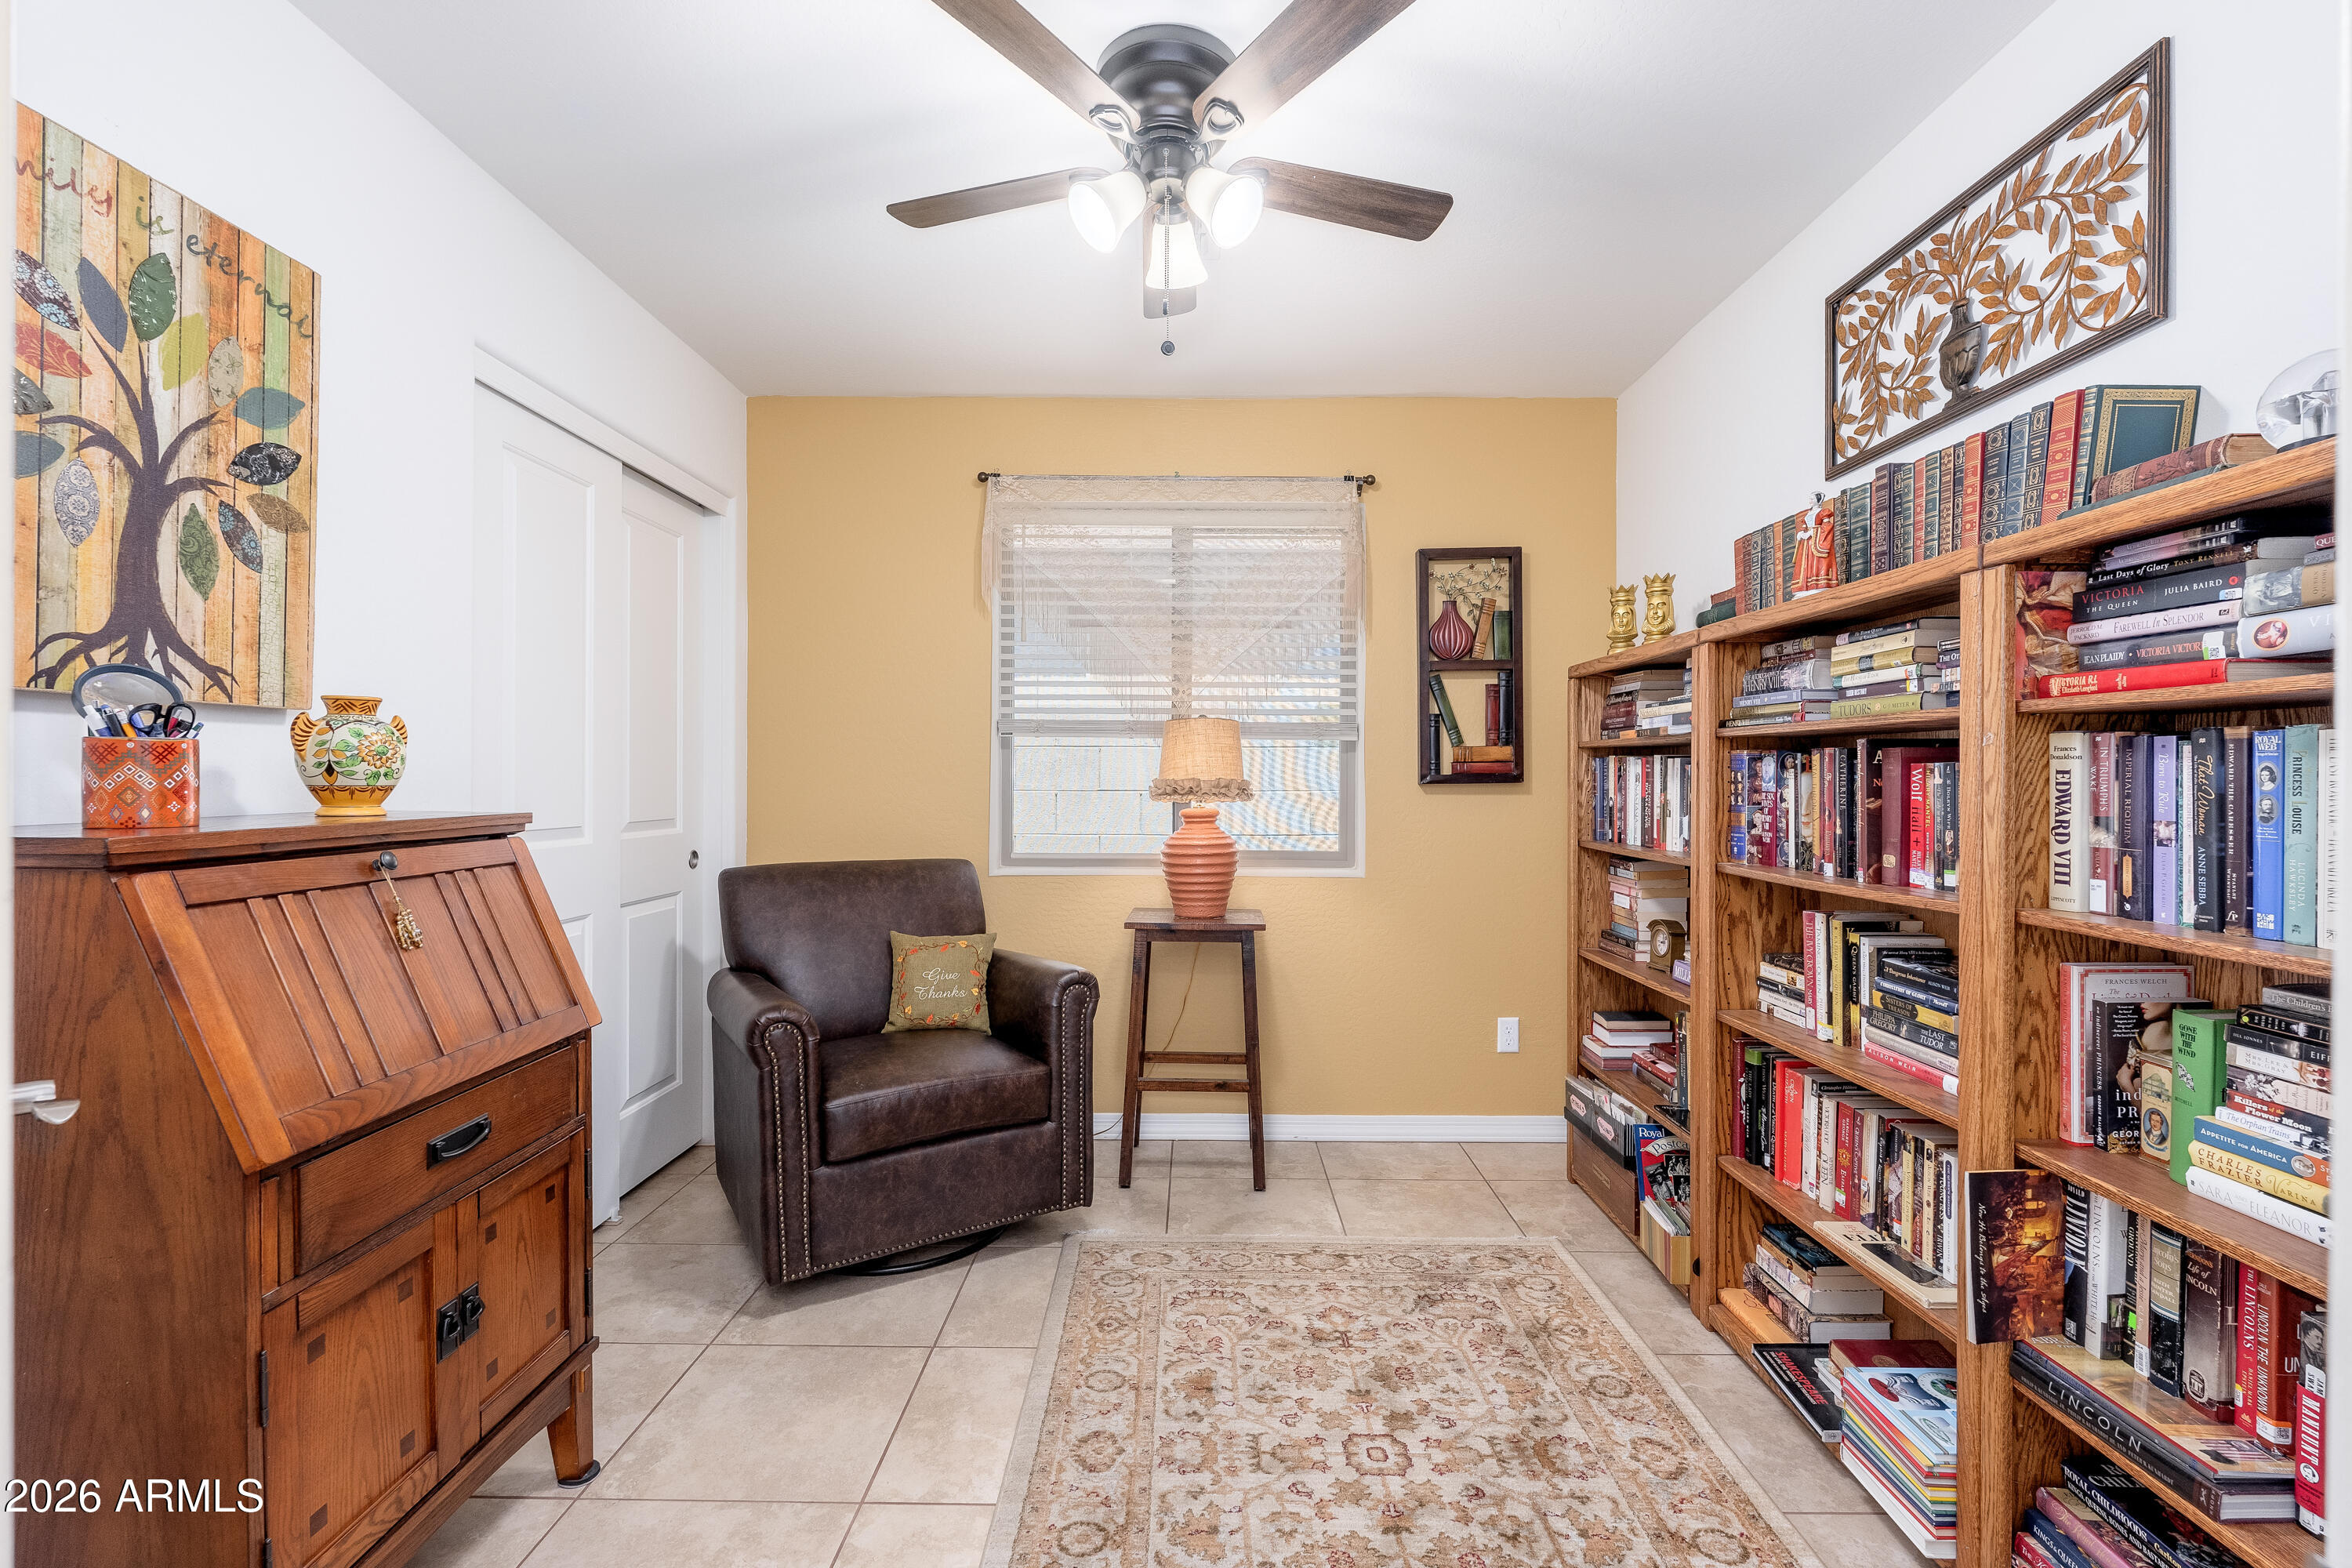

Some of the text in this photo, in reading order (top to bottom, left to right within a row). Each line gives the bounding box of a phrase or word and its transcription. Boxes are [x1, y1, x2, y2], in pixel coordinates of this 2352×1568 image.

[2098, 573, 2114, 582] Last
[2116, 569, 2134, 579] Days
[2136, 565, 2146, 576] of
[2147, 562, 2169, 573] Glory
[2082, 579, 2223, 604] VICTORIA JULIA BAIRD
[2086, 599, 2139, 613] THE QUEEN
[2114, 622, 2151, 633] FAREWELL
[2163, 612, 2205, 626] SPLENDOR
[2074, 632, 2100, 641] PACKARD
[2084, 646, 2171, 665] JEAN PLAIDY VICTORIA
[1745, 677, 1768, 692] HENRY
[1768, 674, 1780, 689] VIII
[1838, 702, 1871, 717] TUDORS
[2255, 735, 2281, 744] ROYAL
[2100, 746, 2109, 812] IN TRIUMPH'S
[2158, 753, 2169, 814] Born Rule
[1911, 768, 1923, 833] Wolf Hall
[2292, 750, 2308, 835] PRINCESS LOUISE
[2050, 768, 2072, 887] EDWARD VIII
[2198, 754, 2215, 906] That Woman ANNE SEBBA
[2288, 859, 2297, 912] HAWKSLEY
[923, 967, 961, 985] Give
[1928, 980, 1941, 989] ALISON
[914, 985, 968, 1000] Thanks
[1886, 996, 1905, 1009] SISTERS
[2271, 993, 2326, 1012] The Children's
[1887, 1004, 1911, 1017] TREASON
[1870, 1016, 1897, 1032] GREGORY
[1920, 1035, 1944, 1050] TUDOR
[1872, 1011, 1946, 1041] PHILIPPA LAST
[2179, 1023, 2198, 1035] GONE
[2180, 1032, 2196, 1043] WITH
[2182, 1040, 2193, 1049] THE
[2243, 1034, 2263, 1044] JONNES
[1867, 1048, 1916, 1073] ALISON WEIR
[2177, 1047, 2196, 1058] WIND
[2234, 1095, 2269, 1111] Killers
[2227, 1111, 2290, 1139] The Orphan Trains
[2245, 1105, 2312, 1133] Flower Moon
[1639, 1127, 1665, 1139] Royal
[2200, 1127, 2237, 1145] APPETITE
[2250, 1145, 2288, 1163] AMERICA
[2198, 1148, 2262, 1178] CHARLES
[2198, 1157, 2316, 1206] FRAZIER VARINA
[1978, 1203, 1987, 1218] Now
[2198, 1181, 2312, 1236] SARA ELEANOR
[1978, 1218, 1987, 1233] He
[2064, 1196, 2088, 1273] LINCOLN
[2092, 1203, 2102, 1268] LINCOLNS
[1975, 1233, 1987, 1267] Belongs
[1980, 1267, 1986, 1276] to
[2154, 1256, 2172, 1272] Sons
[2187, 1261, 2211, 1279] Life of
[1976, 1292, 1989, 1313] Ages
[2243, 1283, 2256, 1351] LINCOLNS
[2256, 1303, 2269, 1414] LINCOLN THE UNKNOWN
[1775, 1352, 1829, 1405] SHAKESPEARE
[2049, 1381, 2141, 1453] LINCOLN
[2300, 1394, 2321, 1466] MANHUNT
[2063, 1466, 2148, 1543] ROYAL CHILDHOODS
[2067, 1480, 2085, 1502] KINGS,
[2085, 1496, 2109, 1523] QUEENS,
[2109, 1515, 2129, 1538] BONES
[2129, 1533, 2142, 1552] AND
[2033, 1524, 2054, 1549] KINGS
[2021, 1544, 2033, 1561] THE
